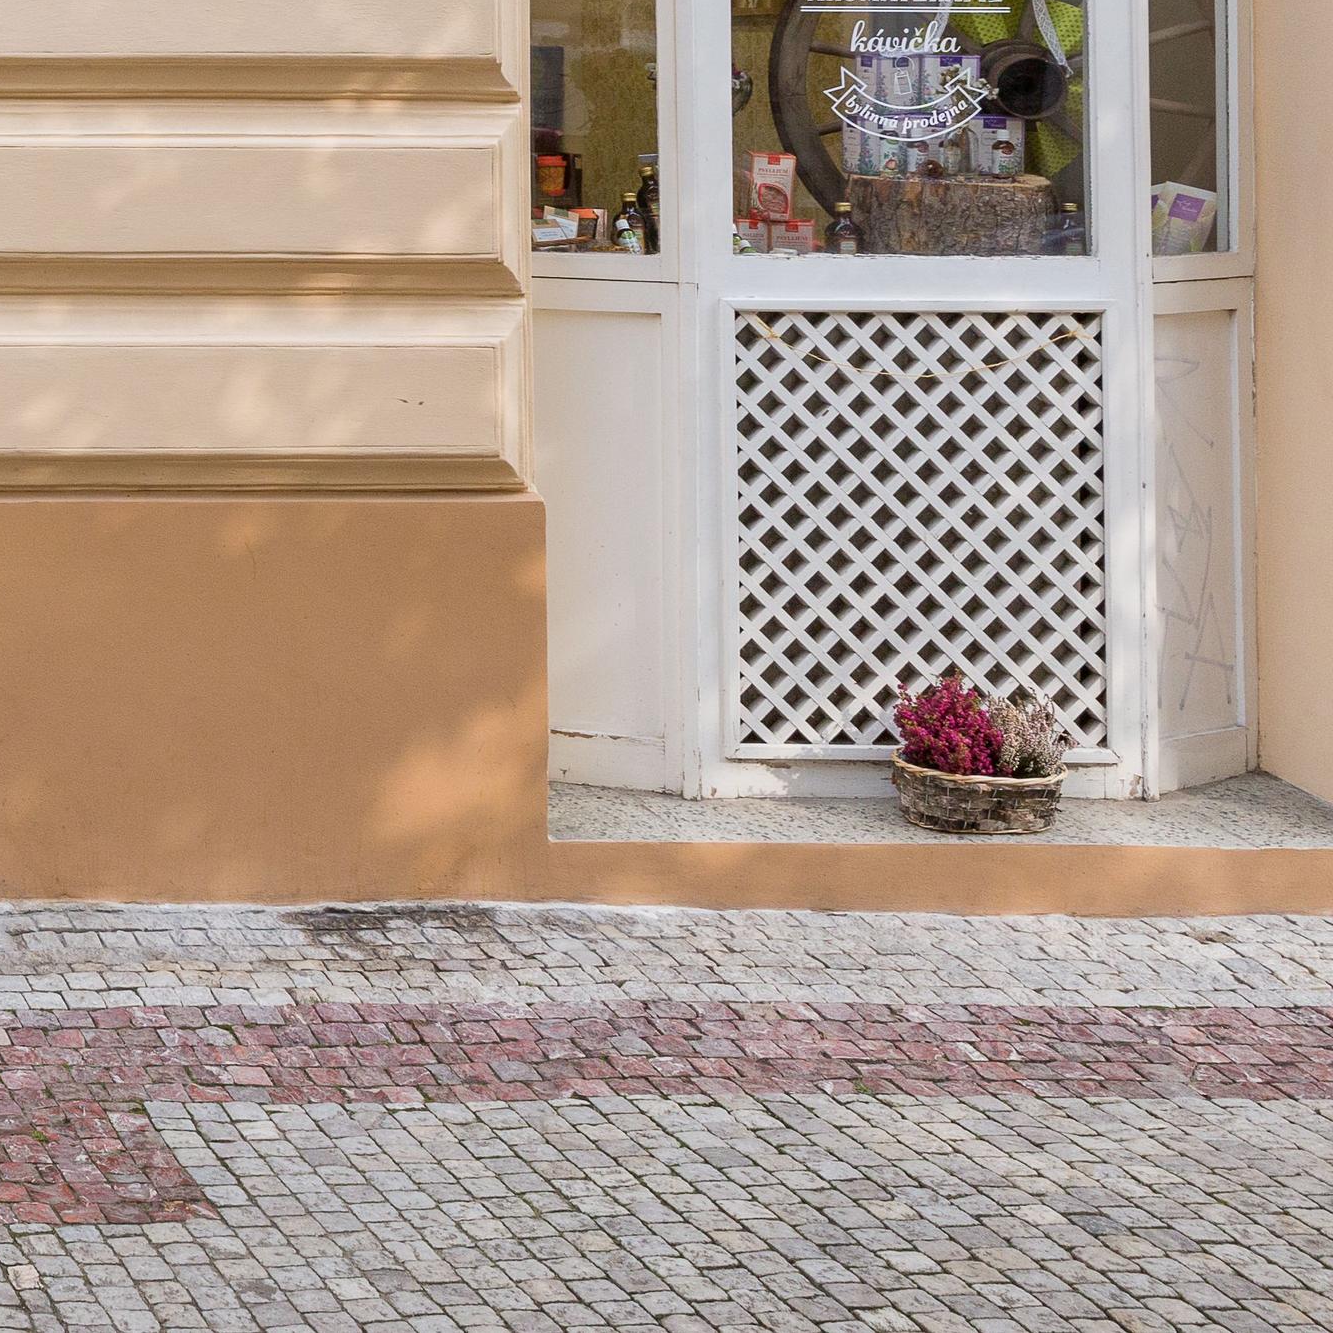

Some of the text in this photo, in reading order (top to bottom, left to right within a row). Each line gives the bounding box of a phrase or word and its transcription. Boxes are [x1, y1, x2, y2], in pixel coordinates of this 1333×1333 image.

[850, 20, 961, 53] kávička
[844, 95, 968, 133] bylinná prodejna
